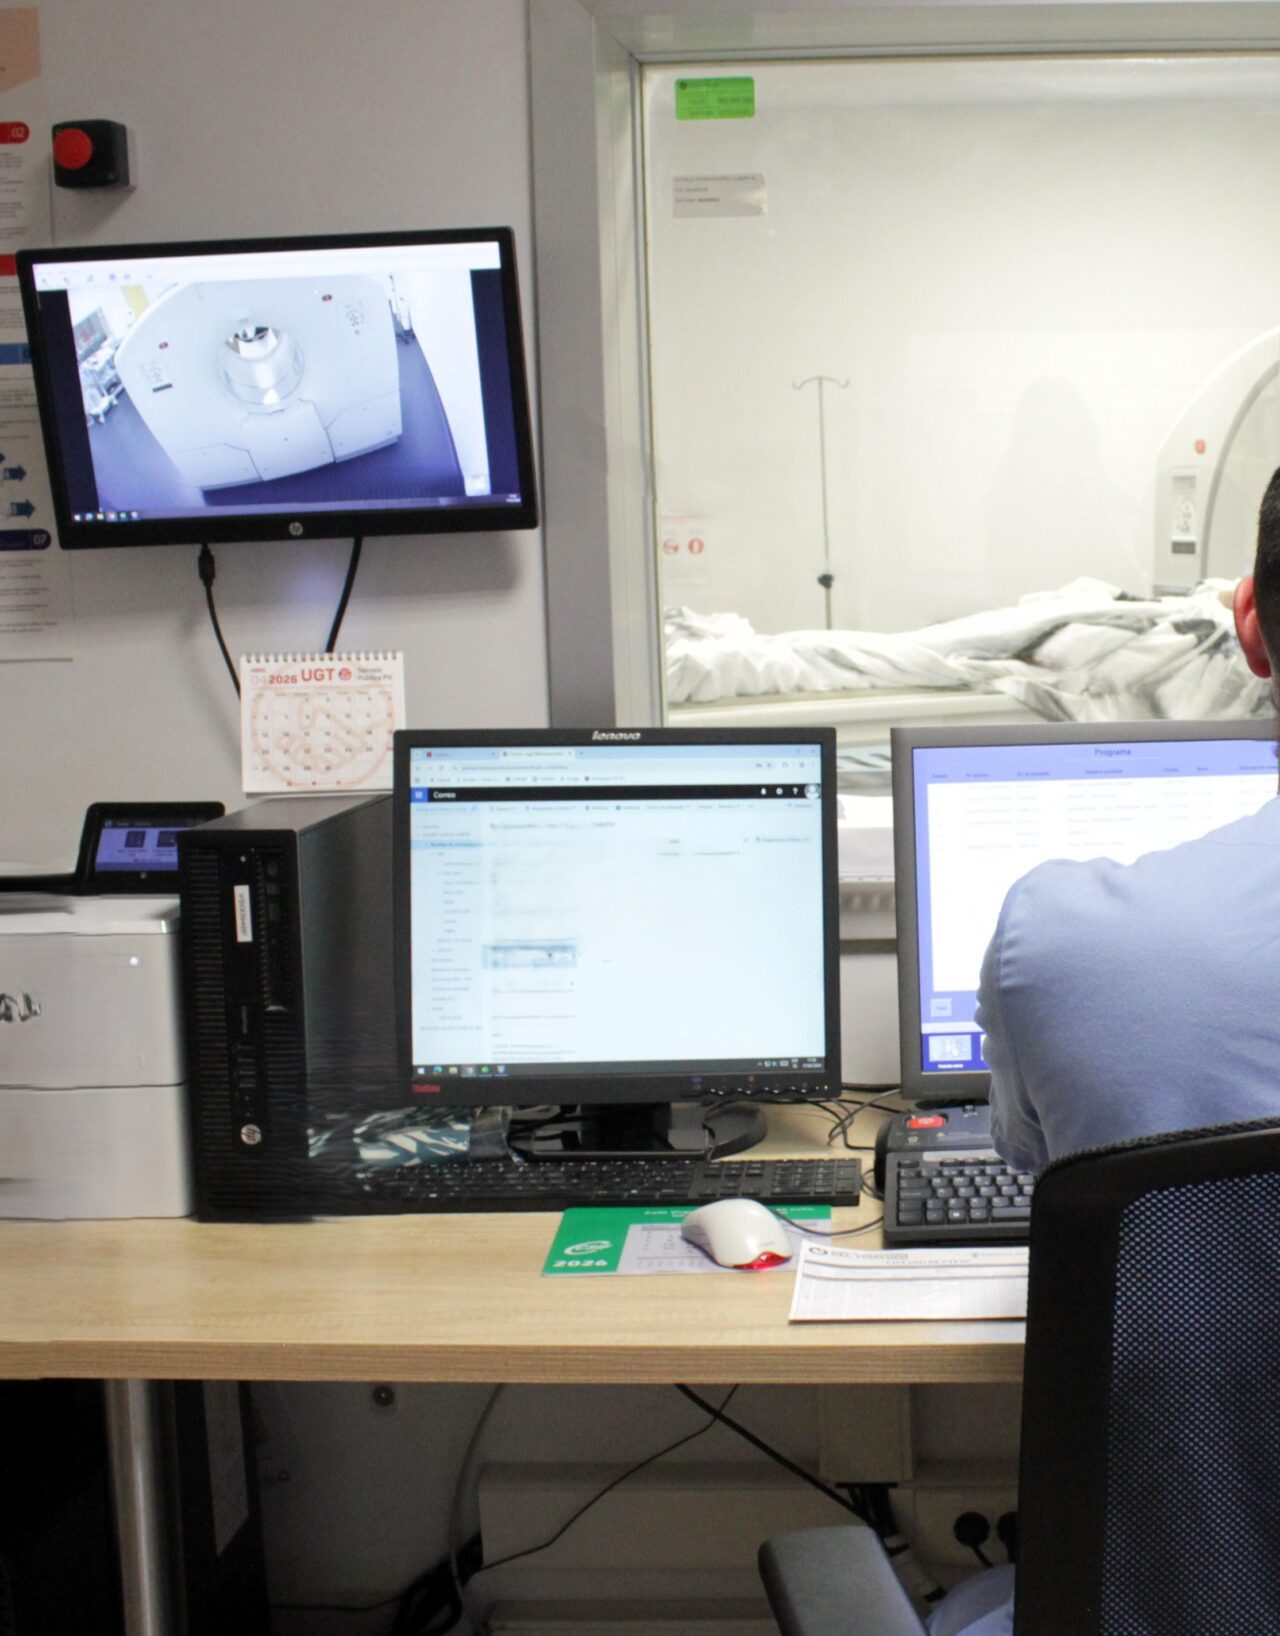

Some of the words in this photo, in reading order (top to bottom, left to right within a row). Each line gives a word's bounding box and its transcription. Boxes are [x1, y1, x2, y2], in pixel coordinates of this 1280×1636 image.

[33, 534, 48, 545] 07
[269, 674, 298, 685] 2026
[301, 668, 335, 682] UGT
[592, 730, 641, 741] lenovo
[1094, 748, 1131, 757] Programa
[433, 791, 456, 800] Correo
[552, 1259, 608, 1268] 2026
